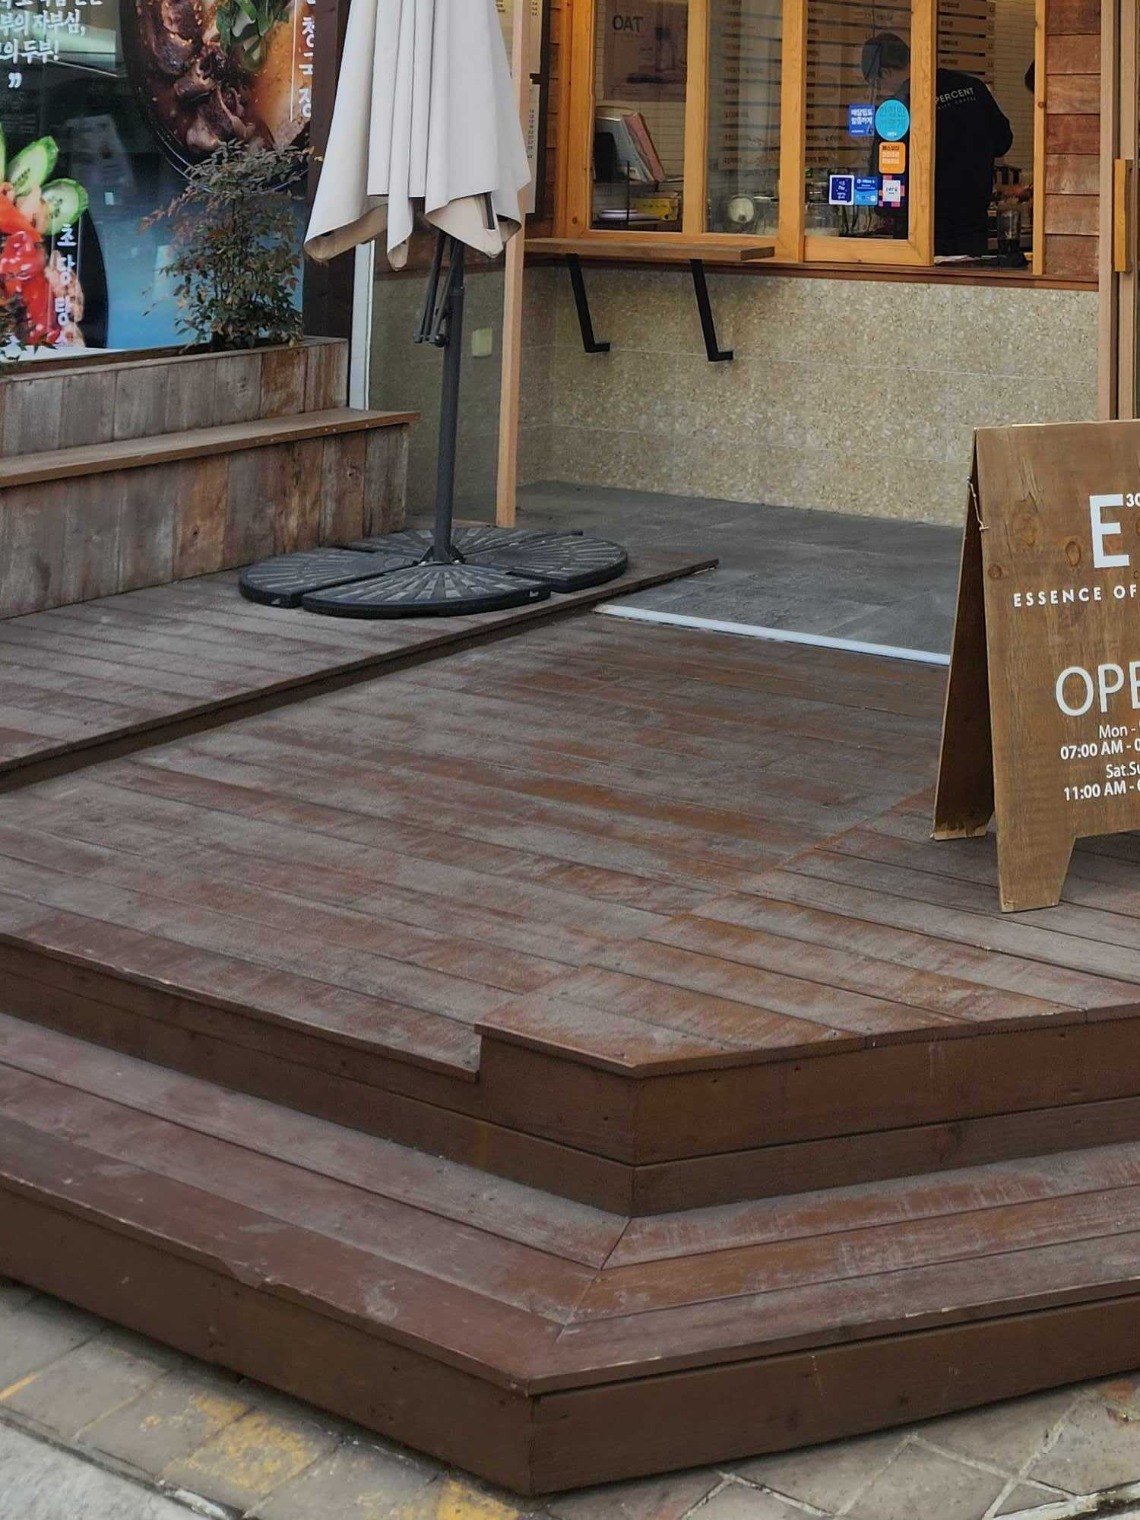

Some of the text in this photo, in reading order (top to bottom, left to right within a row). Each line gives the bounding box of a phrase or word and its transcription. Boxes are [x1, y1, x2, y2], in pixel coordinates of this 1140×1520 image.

[19, 40, 60, 64] 두부!
[1013, 586, 1102, 608] ESSENCE
[1113, 584, 1137, 600] OF
[1099, 724, 1128, 739] Mon
[1060, 744, 1098, 760] 07:00
[1100, 741, 1123, 756] AM
[1064, 784, 1101, 800] 11:00
[1104, 781, 1127, 796] AM
